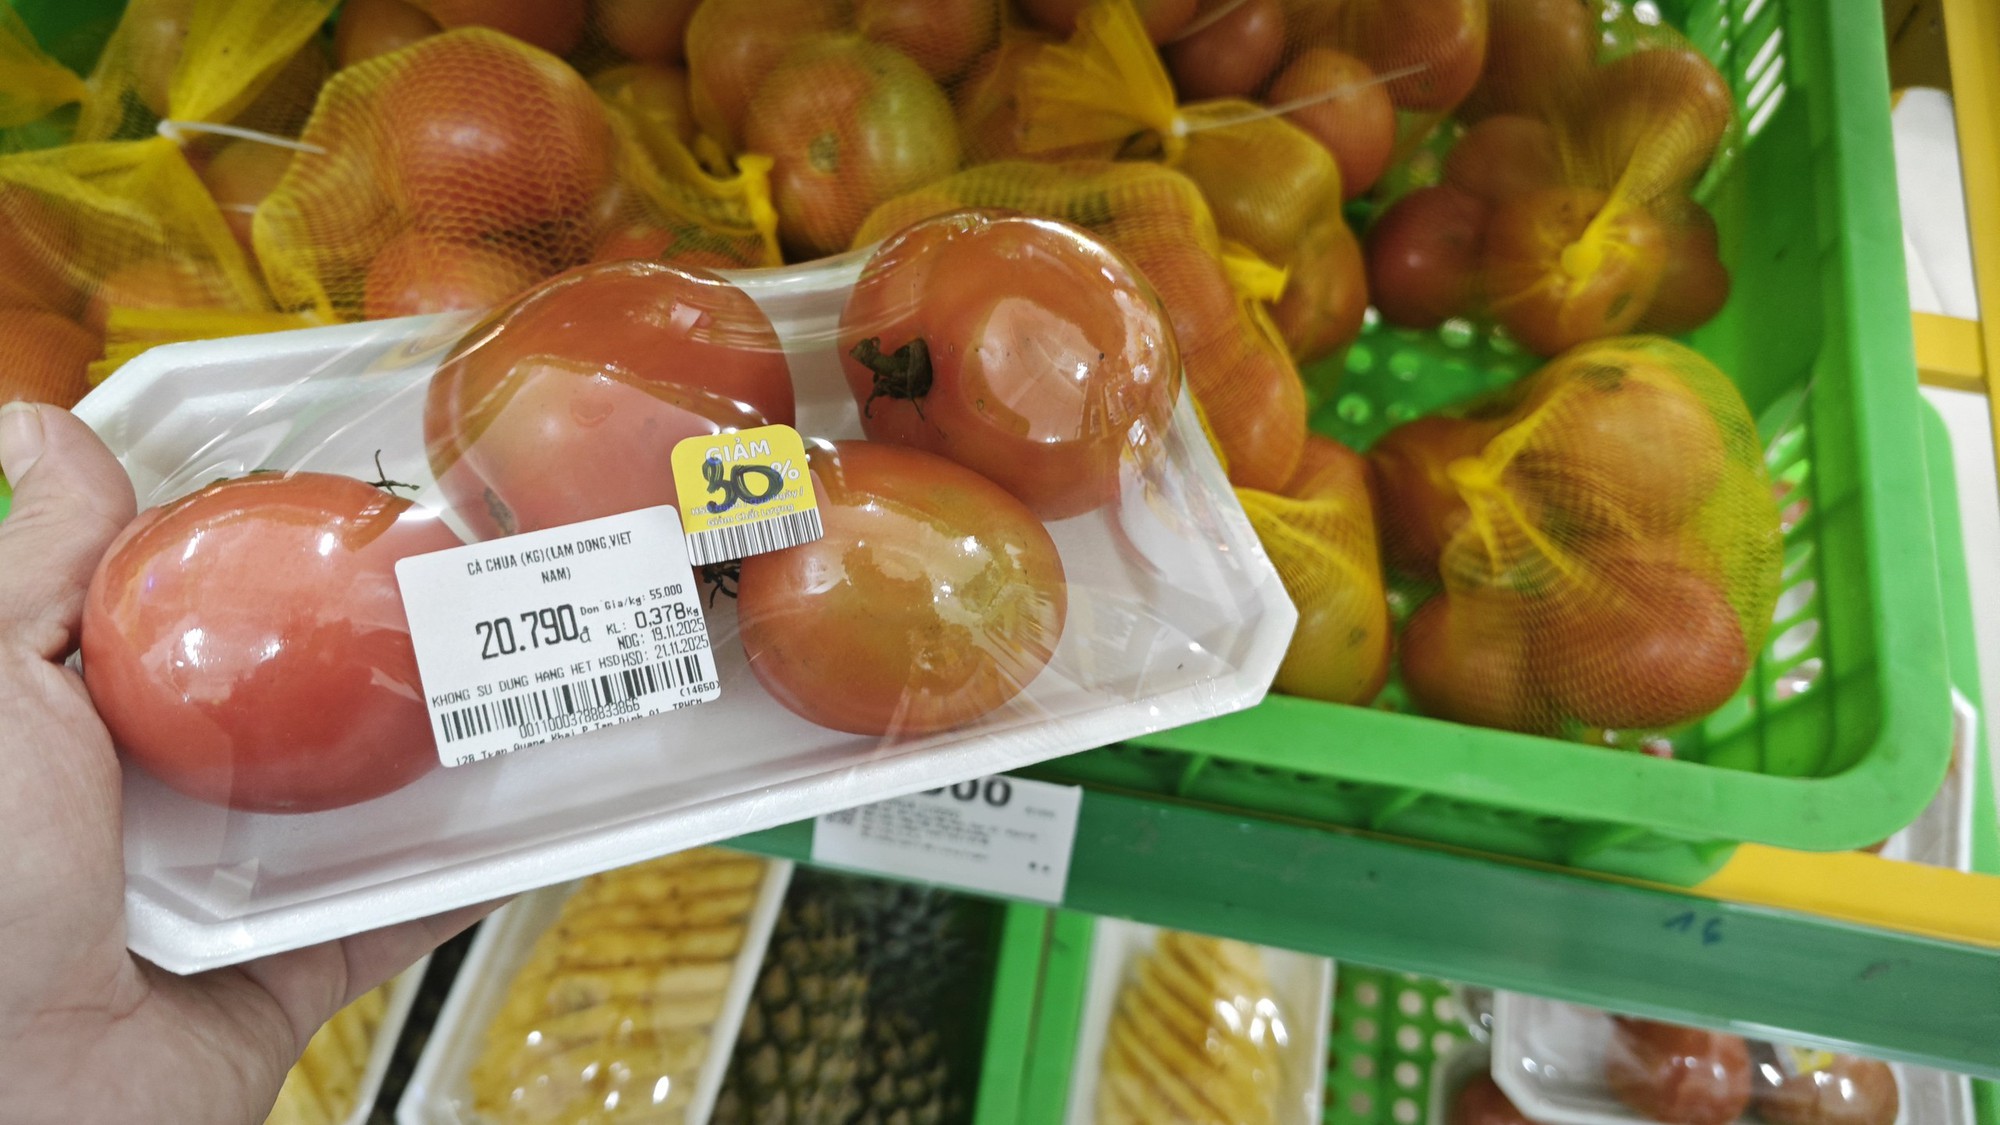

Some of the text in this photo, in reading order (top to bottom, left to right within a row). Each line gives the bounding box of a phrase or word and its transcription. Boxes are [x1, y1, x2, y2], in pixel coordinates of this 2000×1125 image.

[706, 438, 771, 466] GIẢM
[486, 553, 518, 573] CHUA
[541, 566, 571, 584] NAM)
[580, 605, 600, 616] Don
[649, 583, 683, 600] 55.000
[606, 621, 628, 635] KL:
[617, 617, 706, 651] NDG: 19.11.2025
[655, 634, 709, 660] 21.11.2025
[431, 652, 621, 709] KHONG SU DUNG HANG HET HSD
